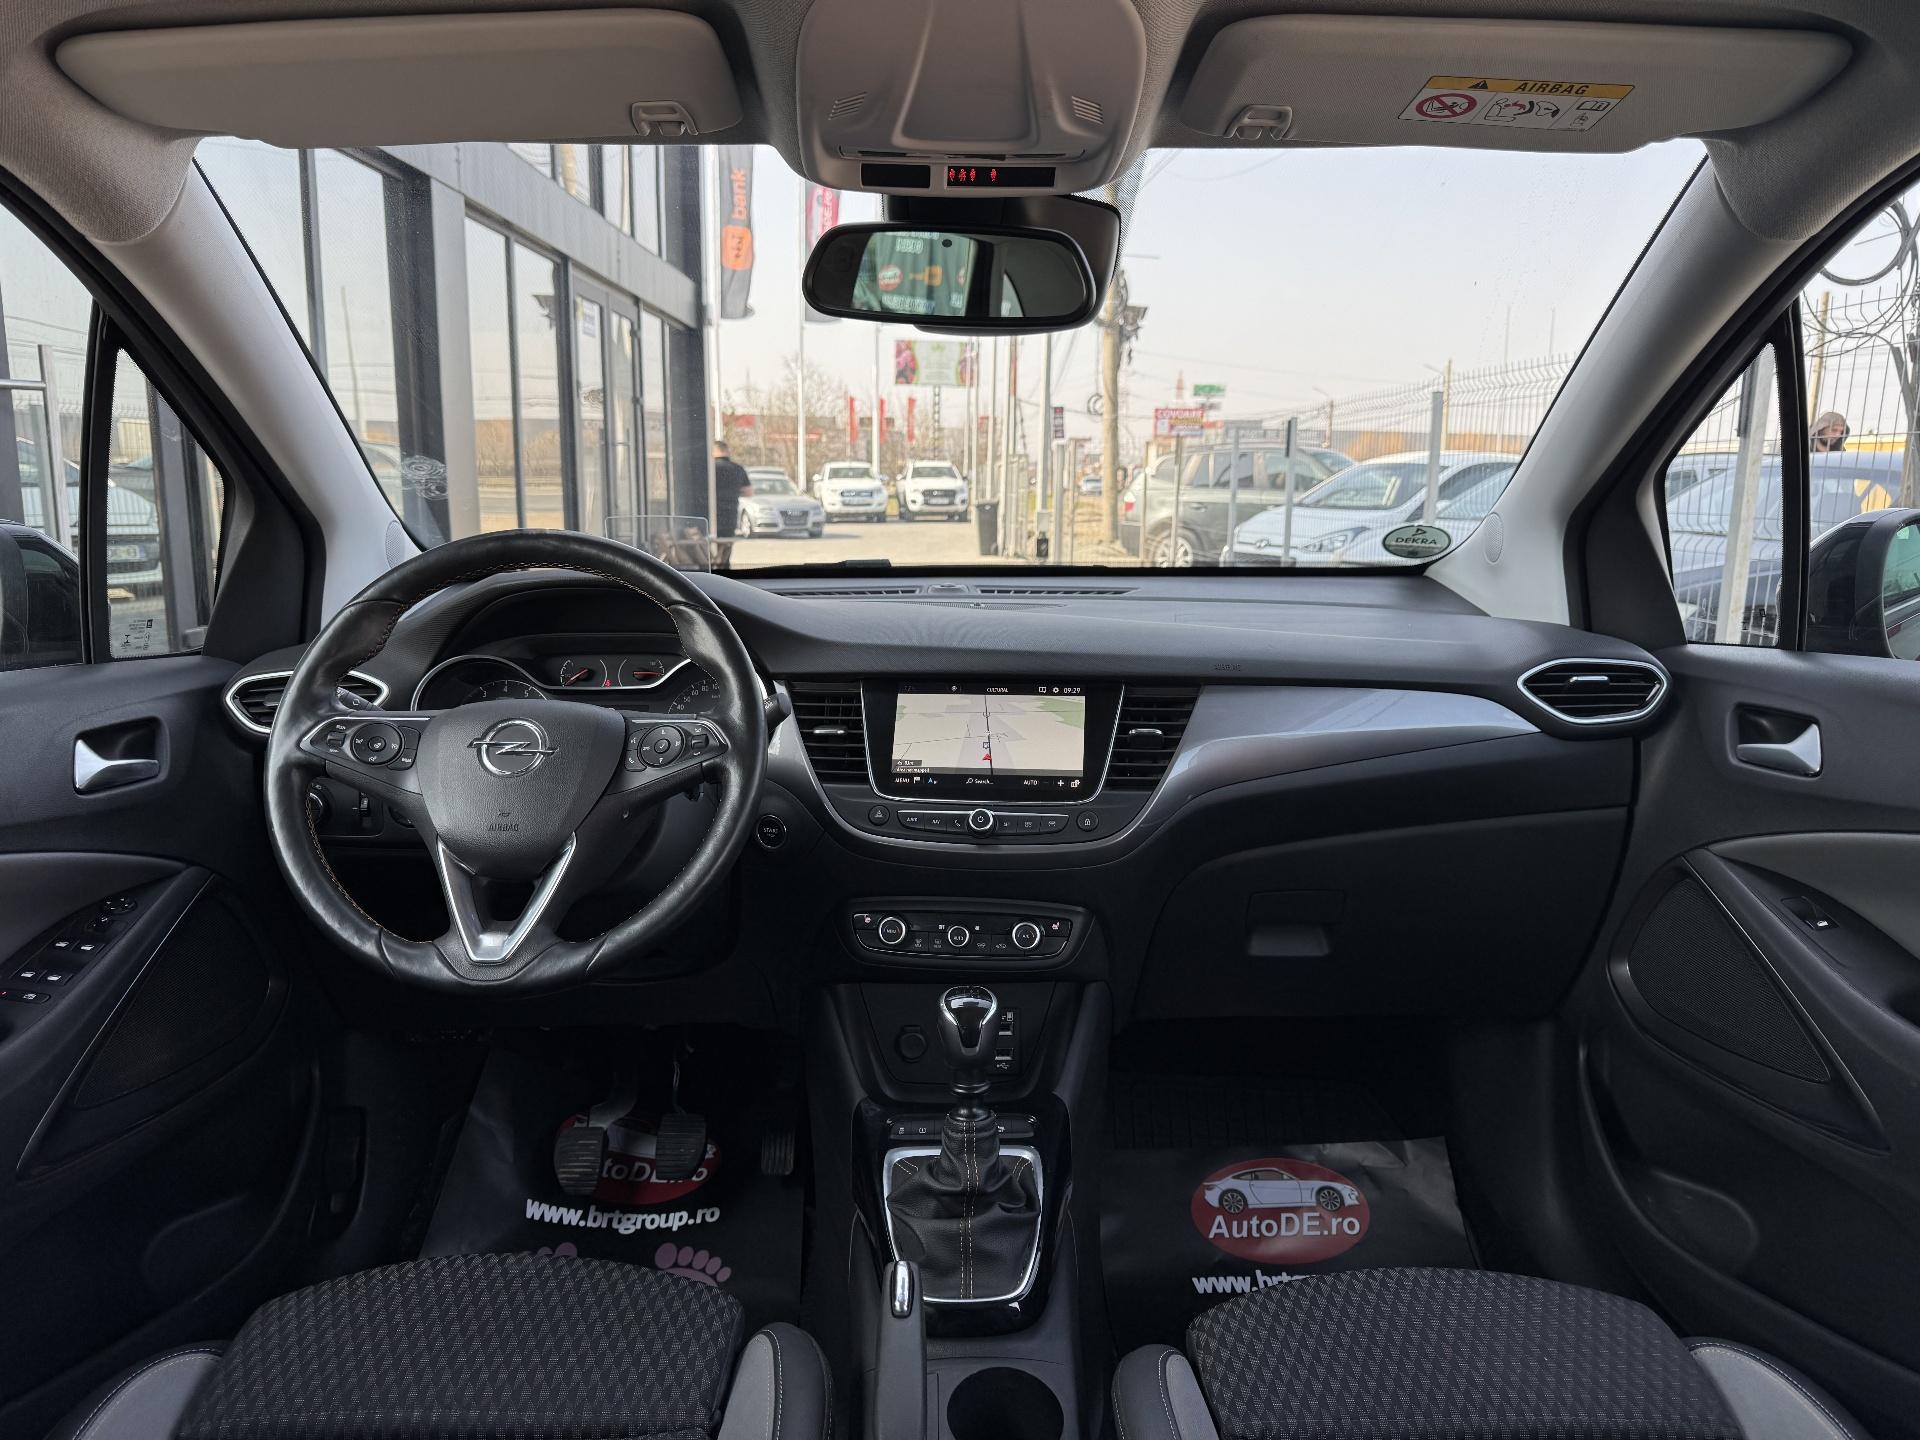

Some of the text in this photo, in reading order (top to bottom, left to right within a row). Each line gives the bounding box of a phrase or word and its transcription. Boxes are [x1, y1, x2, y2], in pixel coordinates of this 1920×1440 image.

[1514, 81, 1590, 95] AIRBAG
[731, 167, 748, 220] bank
[1395, 536, 1438, 545] DEKRA
[525, 1197, 721, 1235] www.brtgroup.ro
[1208, 1212, 1361, 1239] AutoDE.ro
